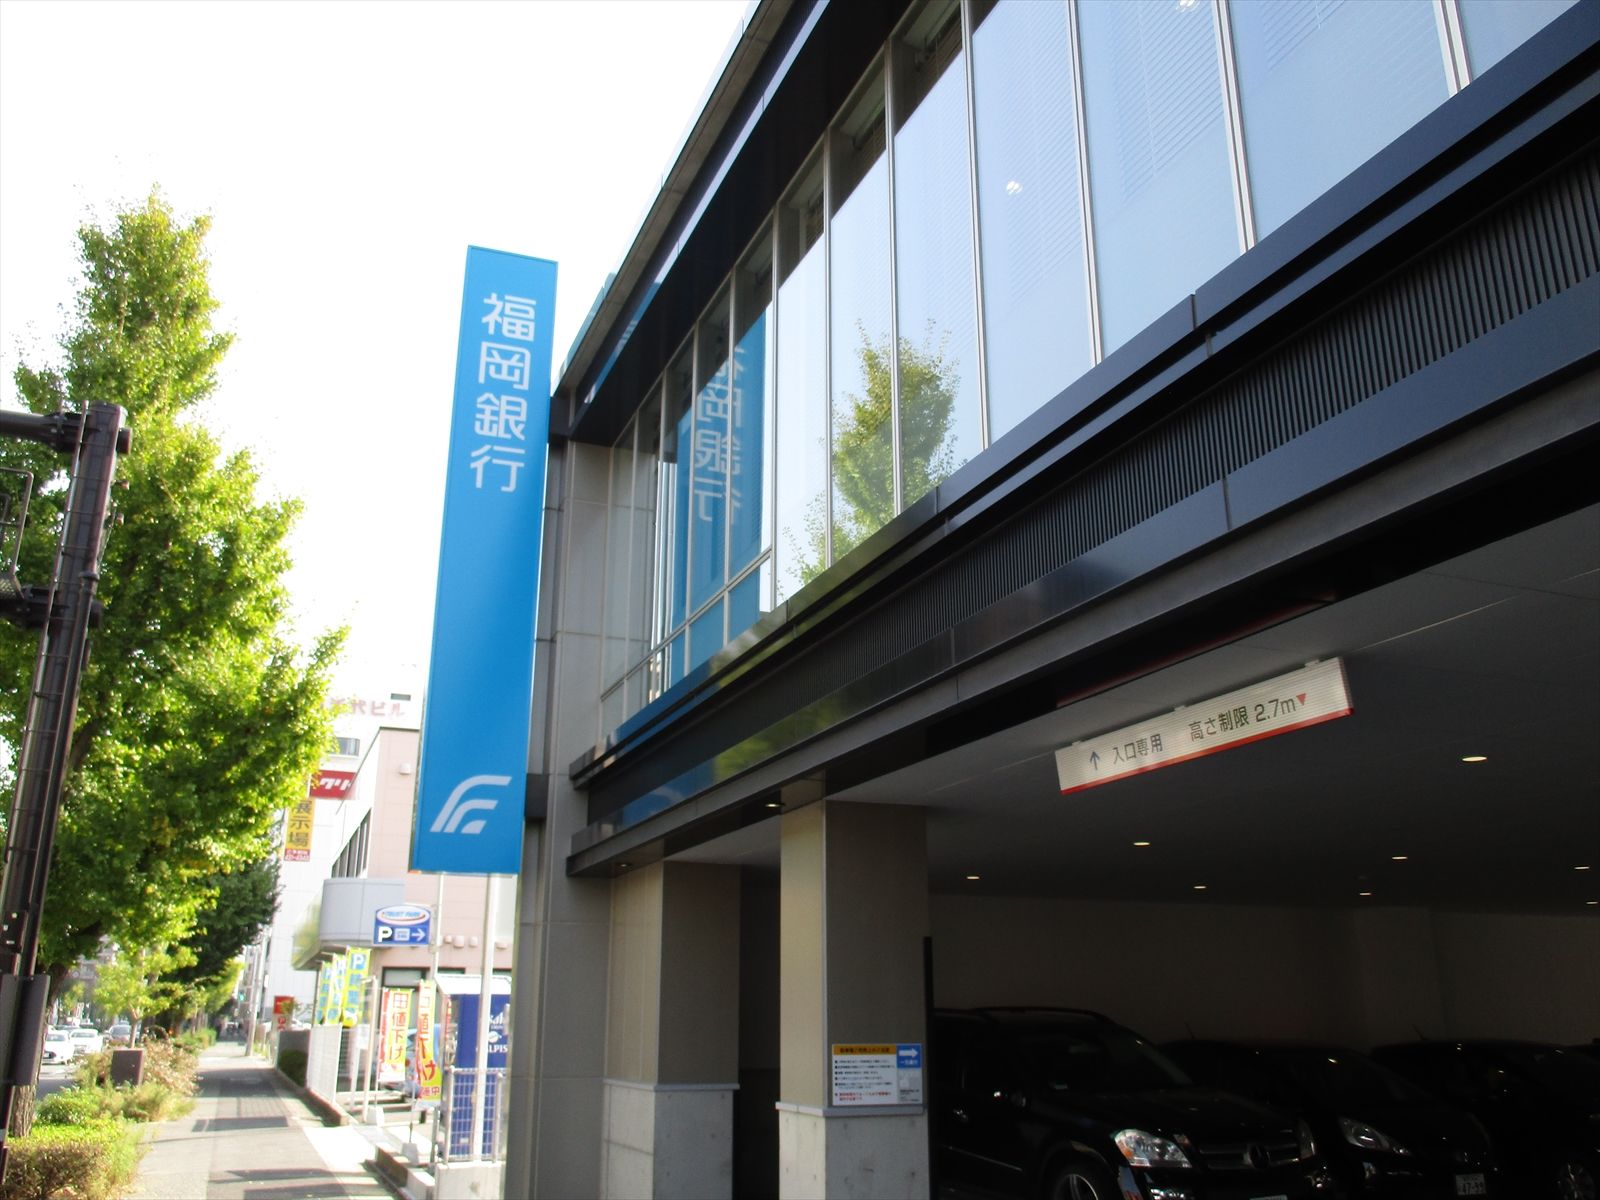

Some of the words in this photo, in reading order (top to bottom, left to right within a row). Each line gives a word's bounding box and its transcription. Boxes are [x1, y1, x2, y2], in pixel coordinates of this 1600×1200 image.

[469, 292, 536, 493] 福岡銀行
[1112, 734, 1163, 765] 入口専用
[1188, 705, 1248, 742] 高さ制限
[1255, 697, 1297, 722] 2.7m
[377, 926, 392, 943] P
[352, 954, 365, 970] P
